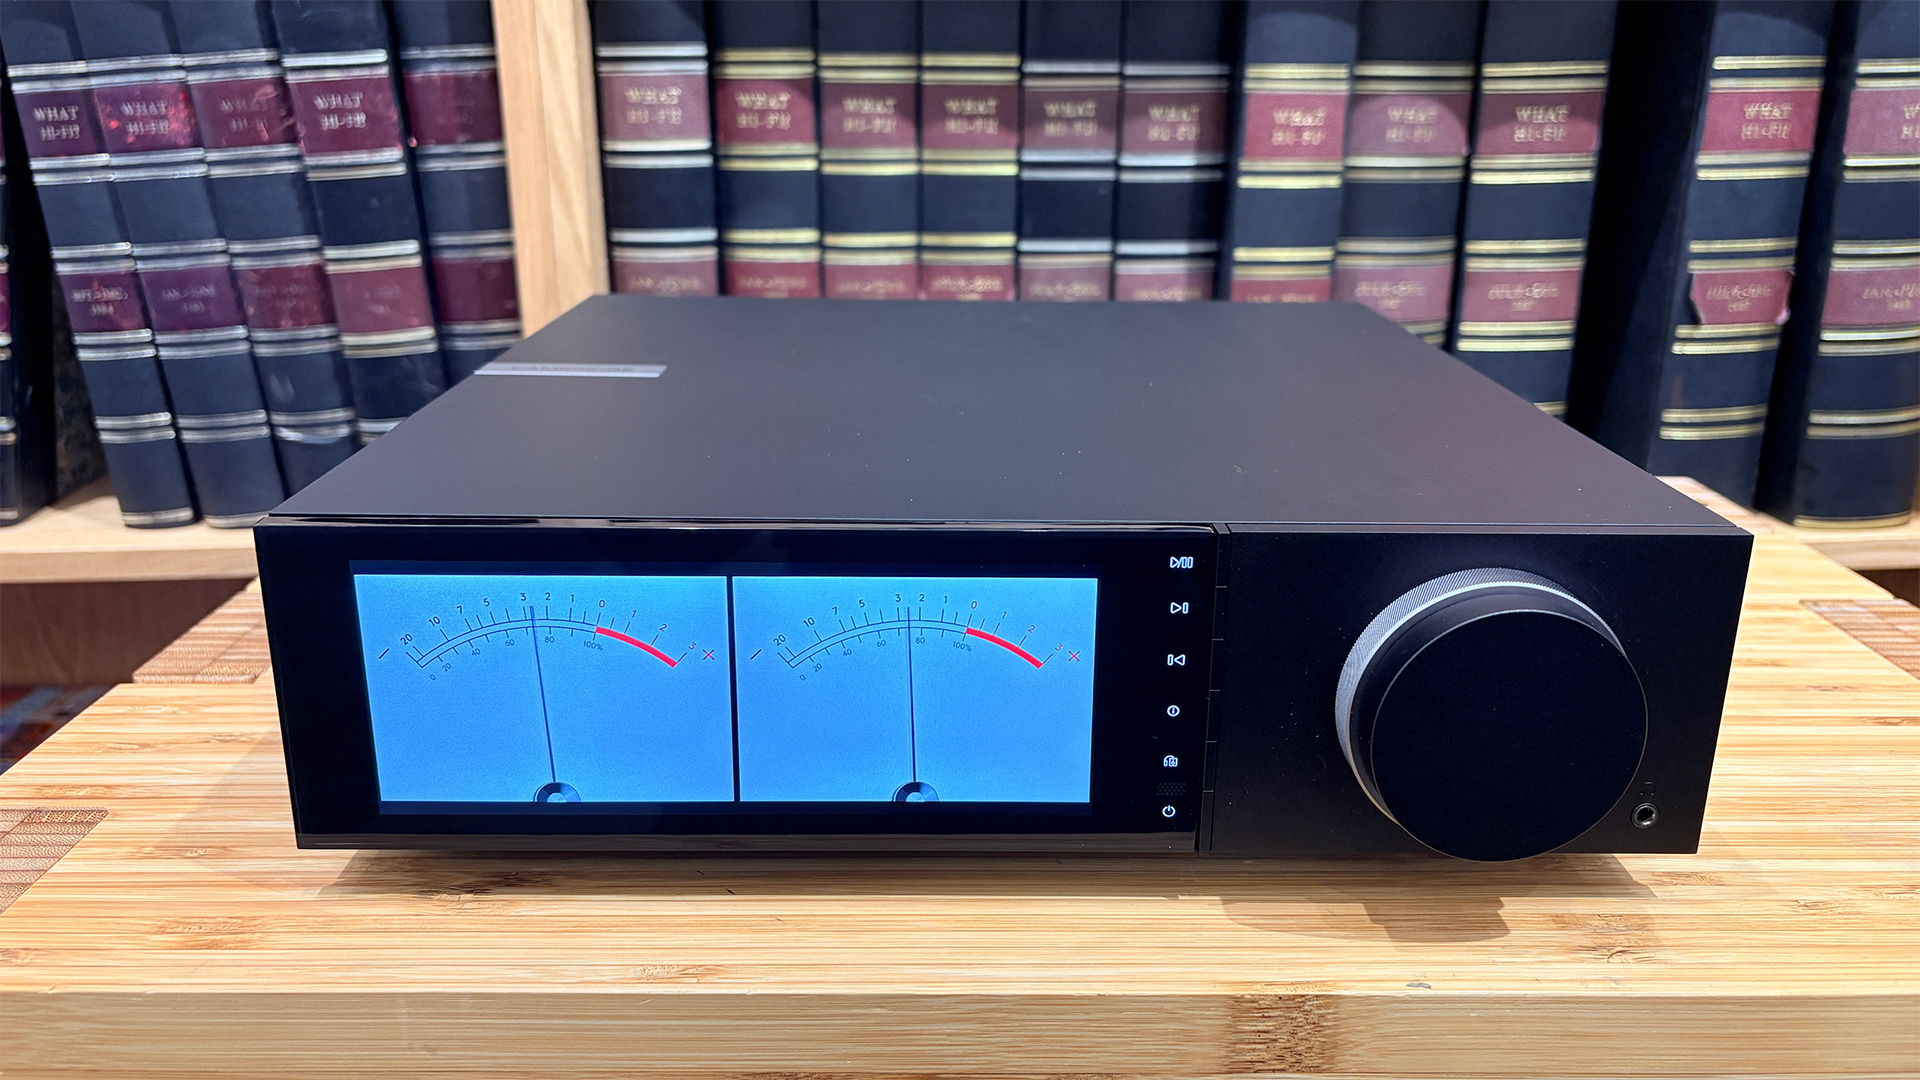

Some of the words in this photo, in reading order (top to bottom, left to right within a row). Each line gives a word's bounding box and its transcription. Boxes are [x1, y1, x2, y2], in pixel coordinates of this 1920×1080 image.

[32, 105, 79, 121] WHAT
[400, 633, 413, 646] 20
[428, 616, 441, 627] 10
[457, 606, 463, 614] 7
[483, 598, 490, 607] 5
[520, 592, 526, 601] 3
[545, 592, 551, 601] 2
[570, 594, 575, 603] 1
[599, 599, 606, 608] 0
[631, 610, 637, 618] 1
[659, 623, 668, 632] 2
[689, 642, 697, 651] 3
[773, 634, 786, 647] 20
[803, 617, 816, 628] 10
[832, 606, 838, 615] 7
[859, 599, 865, 608] 5
[895, 594, 901, 602] 3
[919, 594, 925, 602] 2
[943, 596, 948, 604] 1
[970, 601, 978, 609] 0
[1001, 611, 1008, 620] 1
[1028, 624, 1036, 634] 2
[1055, 642, 1064, 652] 3
[442, 662, 452, 672] 20
[471, 647, 481, 657] 40
[505, 639, 515, 647] 60
[544, 636, 555, 644] 80
[582, 640, 604, 651] 100%
[812, 663, 823, 673] 20
[842, 648, 853, 657] 40
[876, 639, 886, 648] 60
[915, 636, 926, 645] 80
[953, 641, 973, 653] 100%
